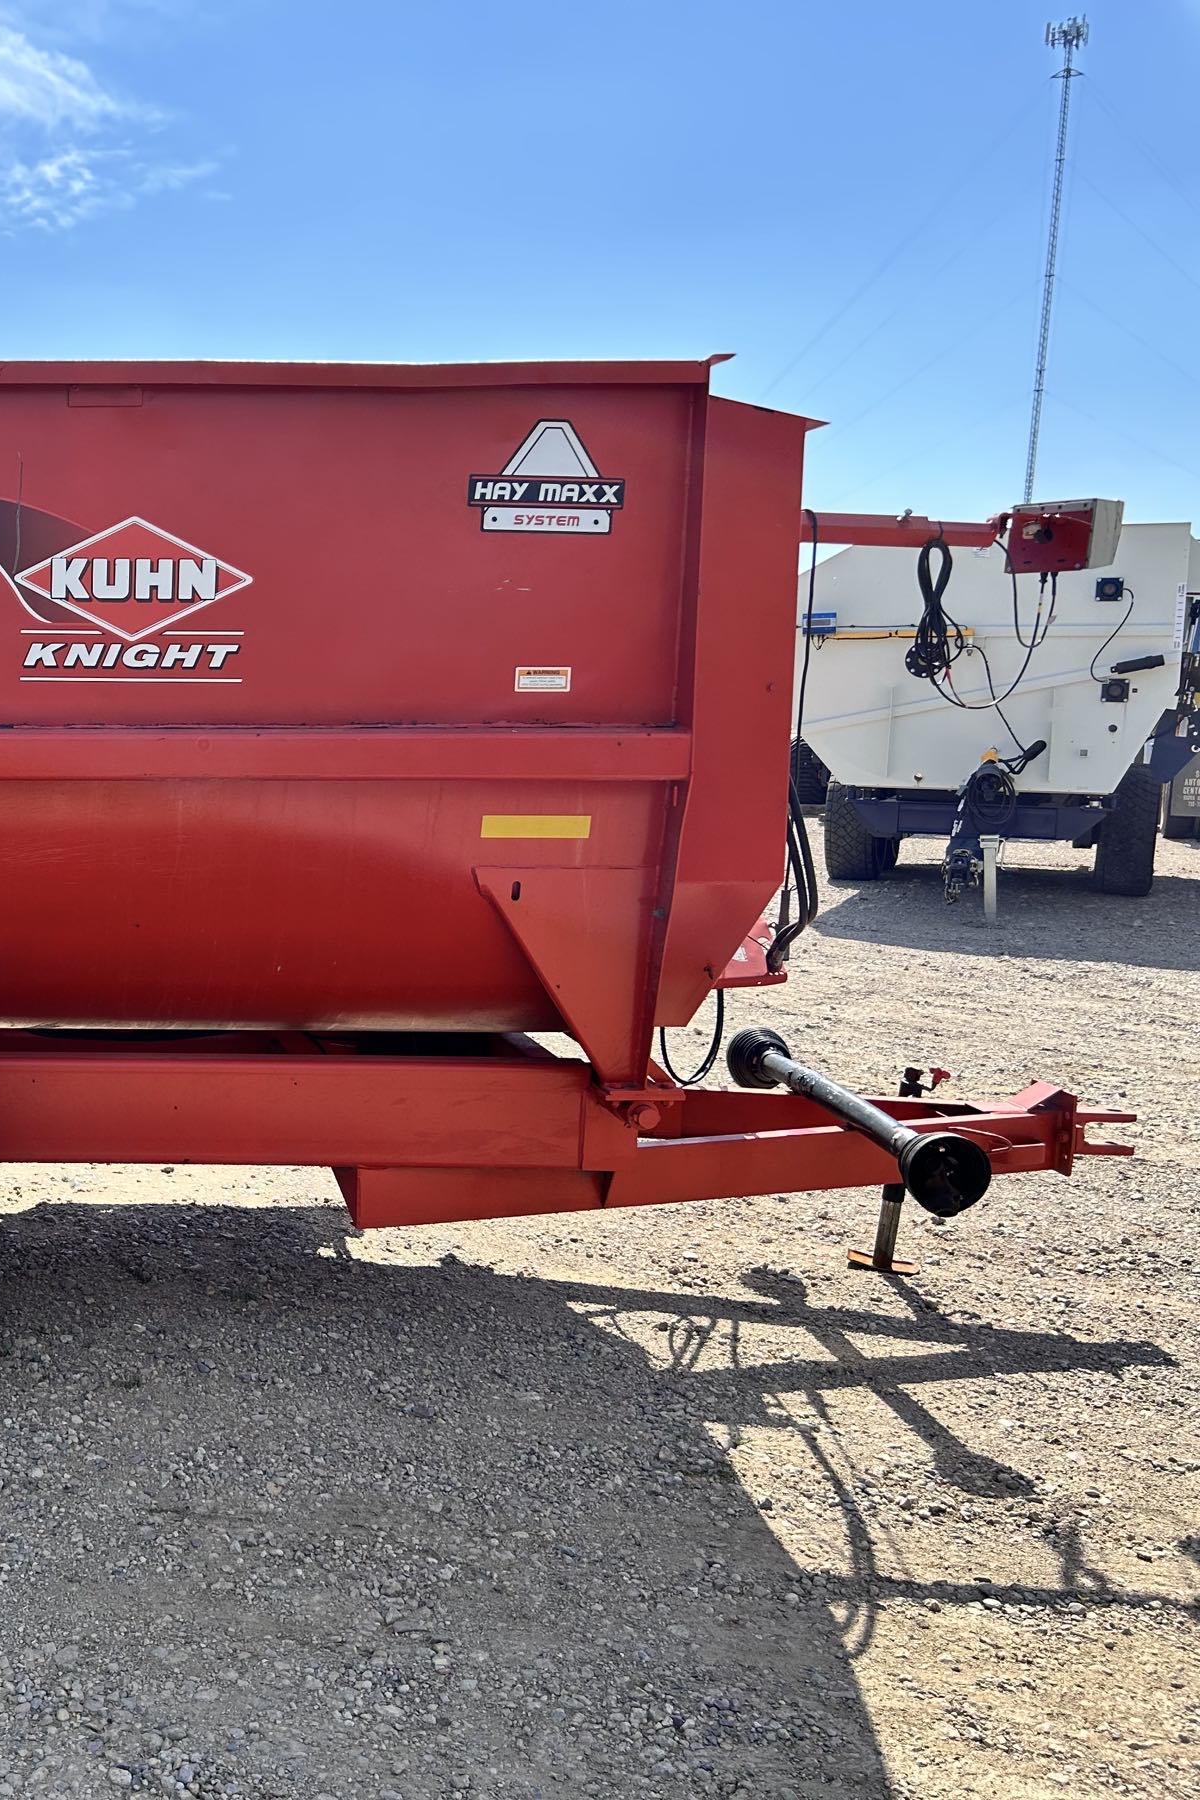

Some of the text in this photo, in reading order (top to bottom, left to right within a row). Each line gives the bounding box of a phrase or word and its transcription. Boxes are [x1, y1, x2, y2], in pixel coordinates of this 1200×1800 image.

[474, 481, 620, 503] HAY MAXX
[513, 514, 580, 527] SYSTEM
[50, 557, 217, 602] KUHN
[22, 643, 239, 669] KNIGHT
